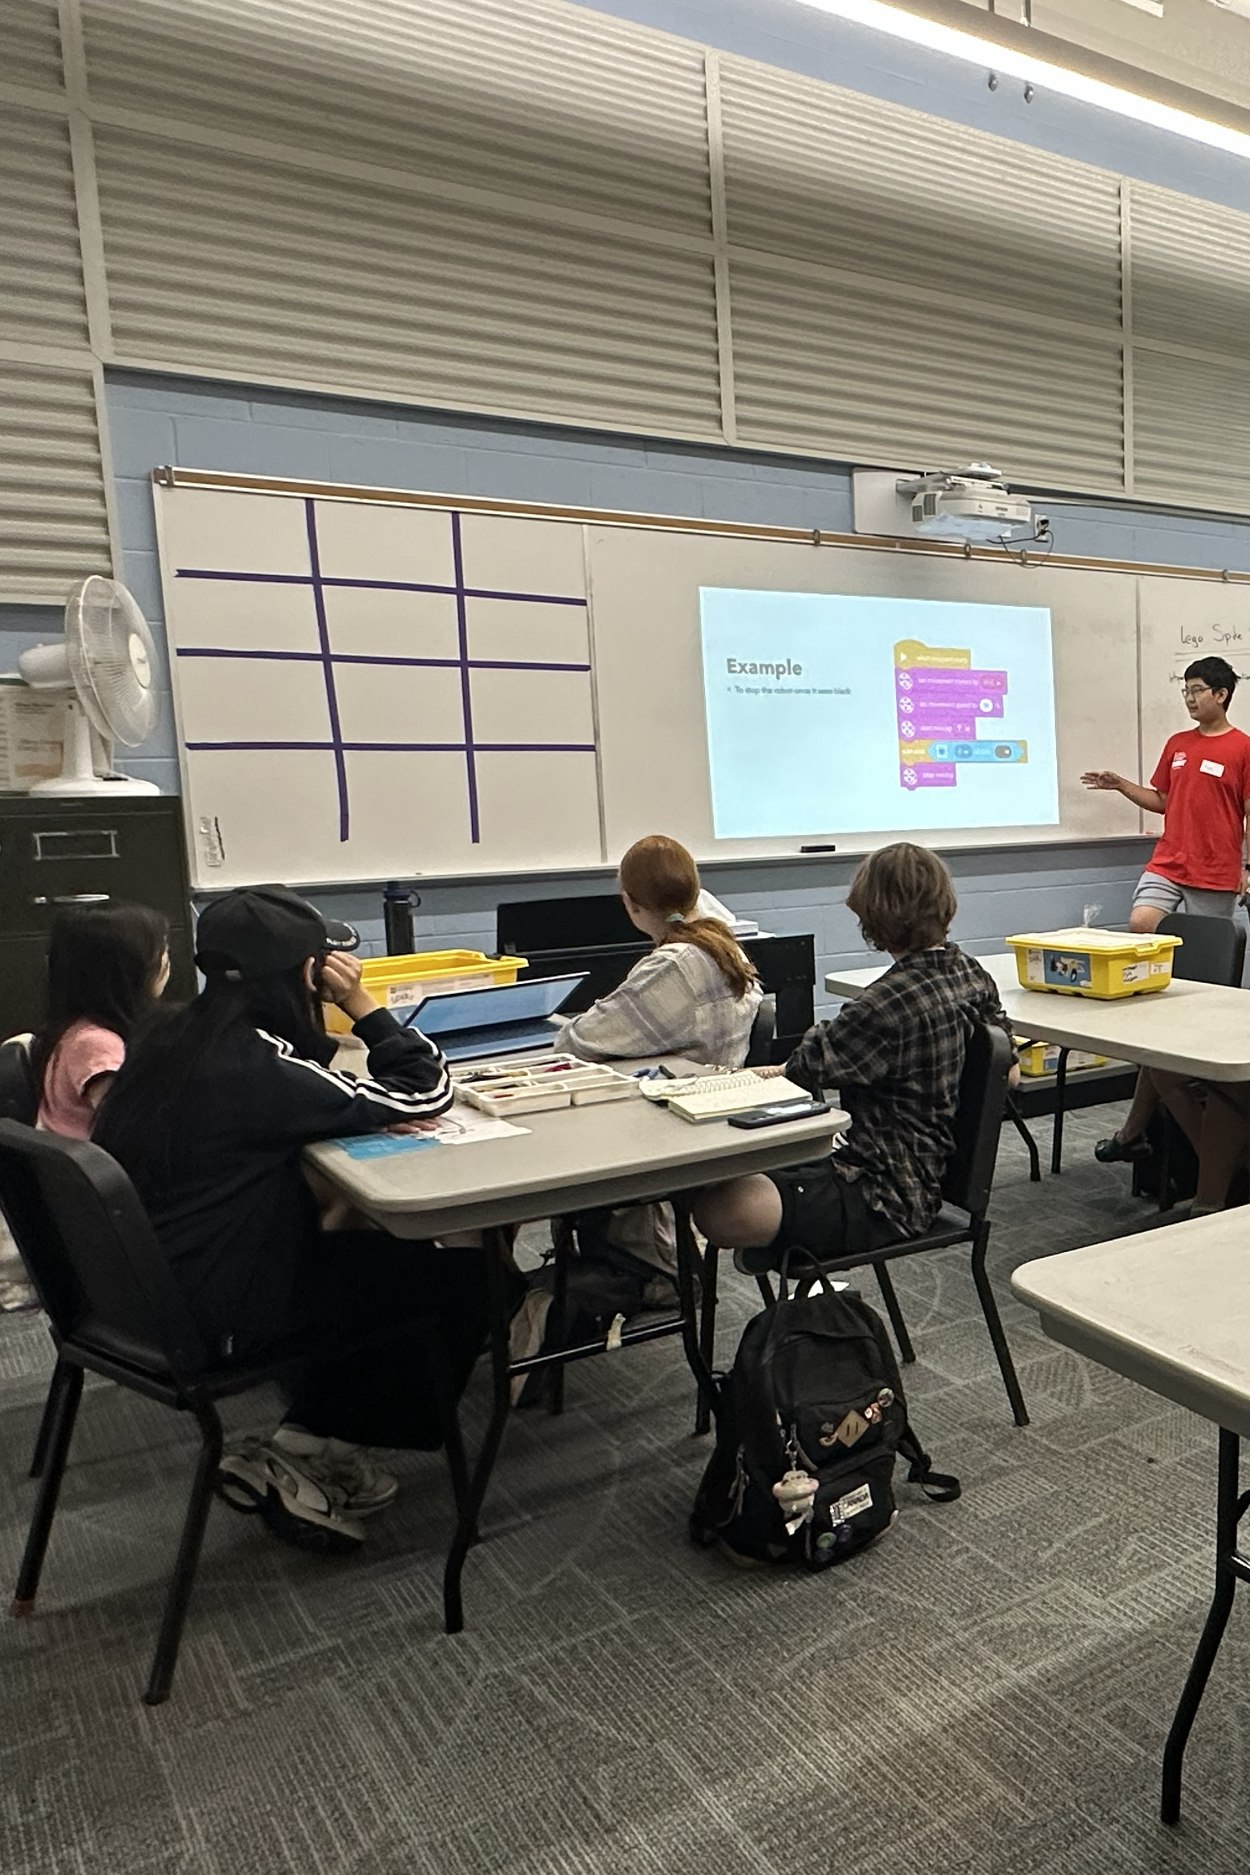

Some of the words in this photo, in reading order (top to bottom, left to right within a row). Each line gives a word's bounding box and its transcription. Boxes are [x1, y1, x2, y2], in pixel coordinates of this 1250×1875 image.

[1180, 625, 1204, 648] Lego
[1212, 623, 1243, 646] Spike
[726, 658, 803, 680] Example
[734, 685, 744, 694] To
